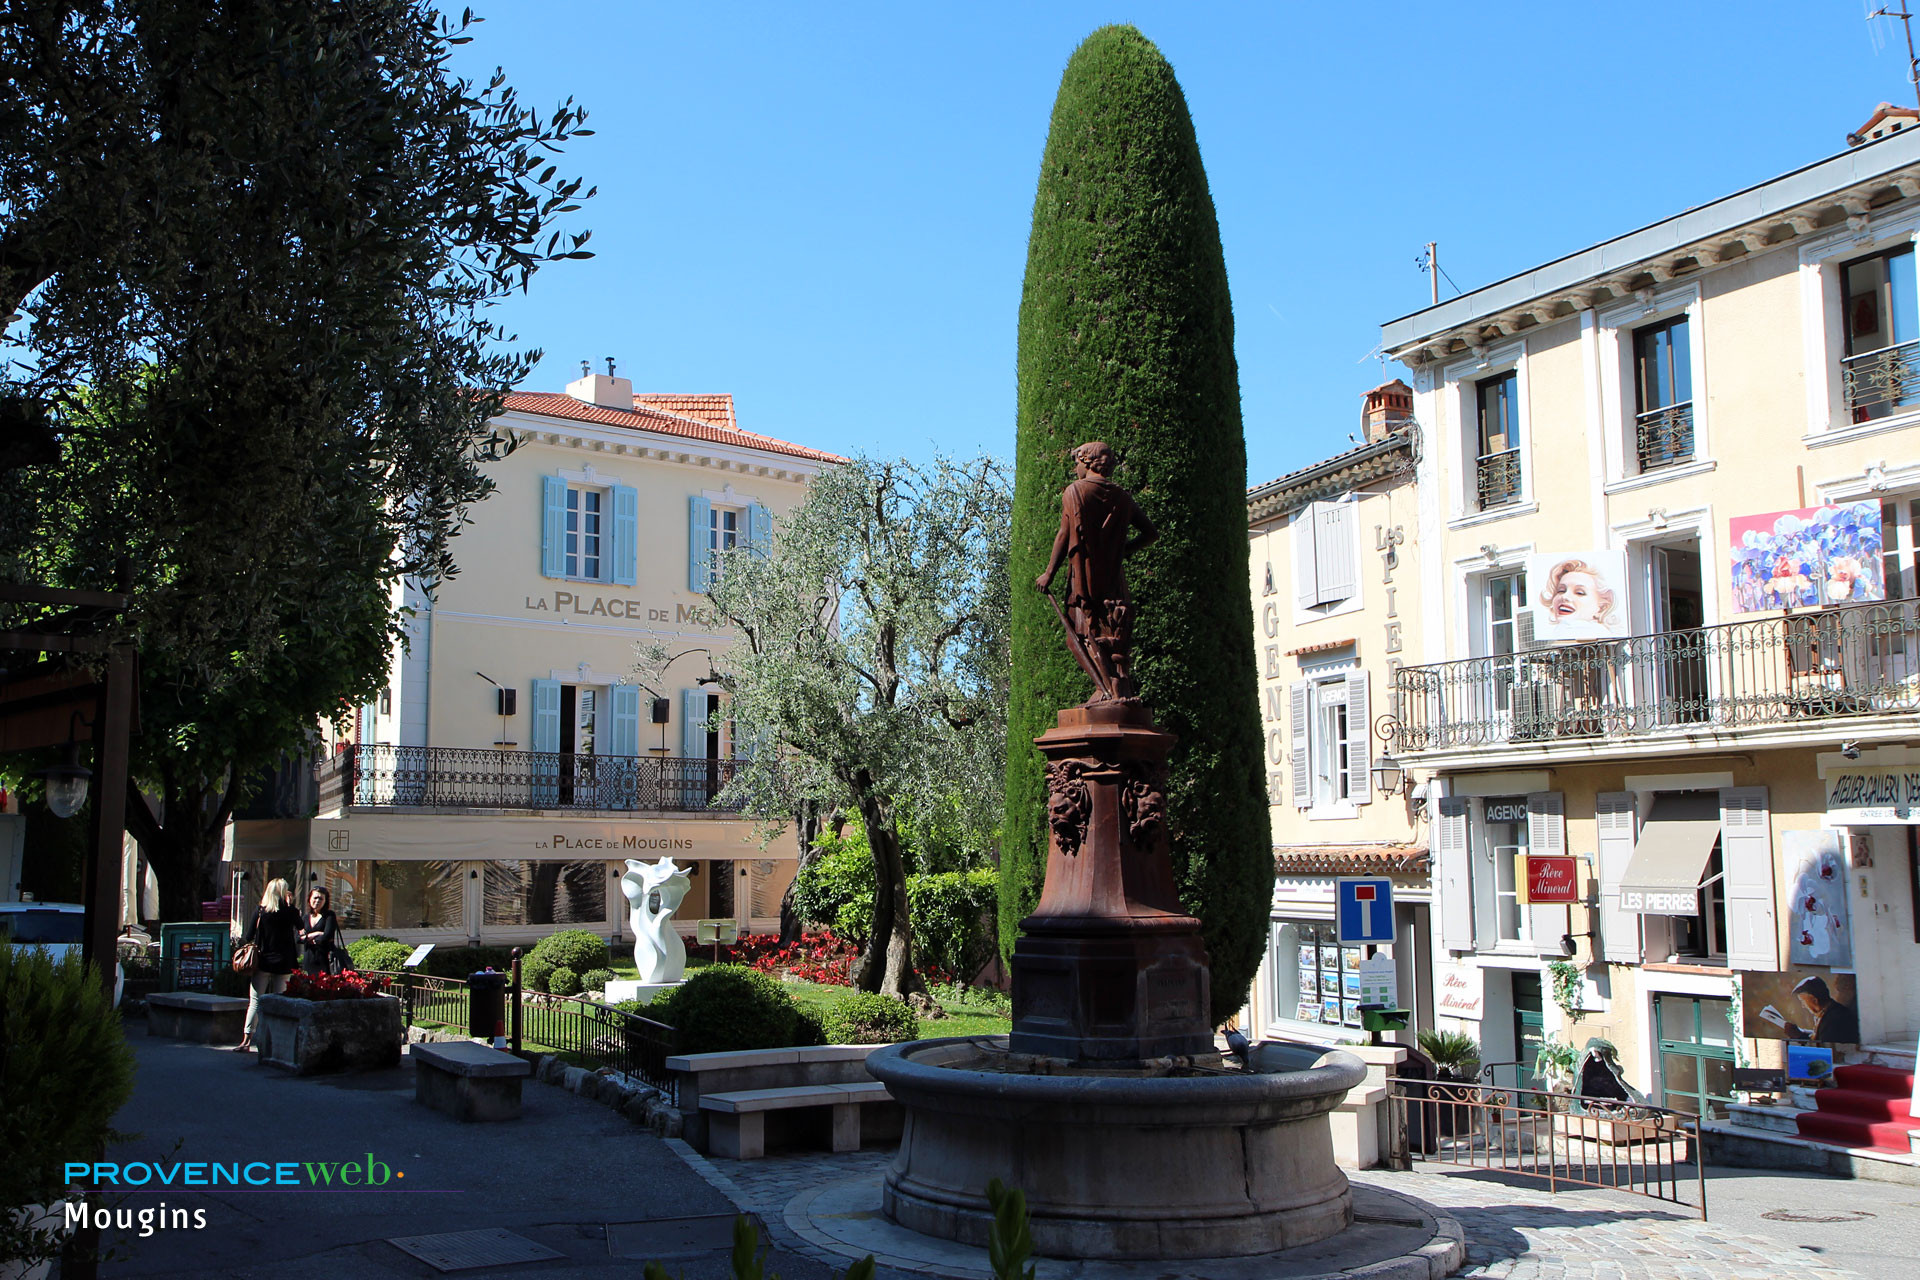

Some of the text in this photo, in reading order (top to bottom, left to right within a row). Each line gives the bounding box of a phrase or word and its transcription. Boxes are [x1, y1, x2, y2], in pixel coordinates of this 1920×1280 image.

[1374, 524, 1404, 552] Les
[525, 596, 548, 611] LA
[554, 591, 641, 620] PLACE
[648, 608, 669, 623] DE
[1262, 561, 1283, 806] AGENCE
[534, 841, 548, 849] LA
[553, 835, 603, 849] PLACE
[622, 835, 693, 849] MOUGINS
[1622, 891, 1697, 912] LES PIERRES
